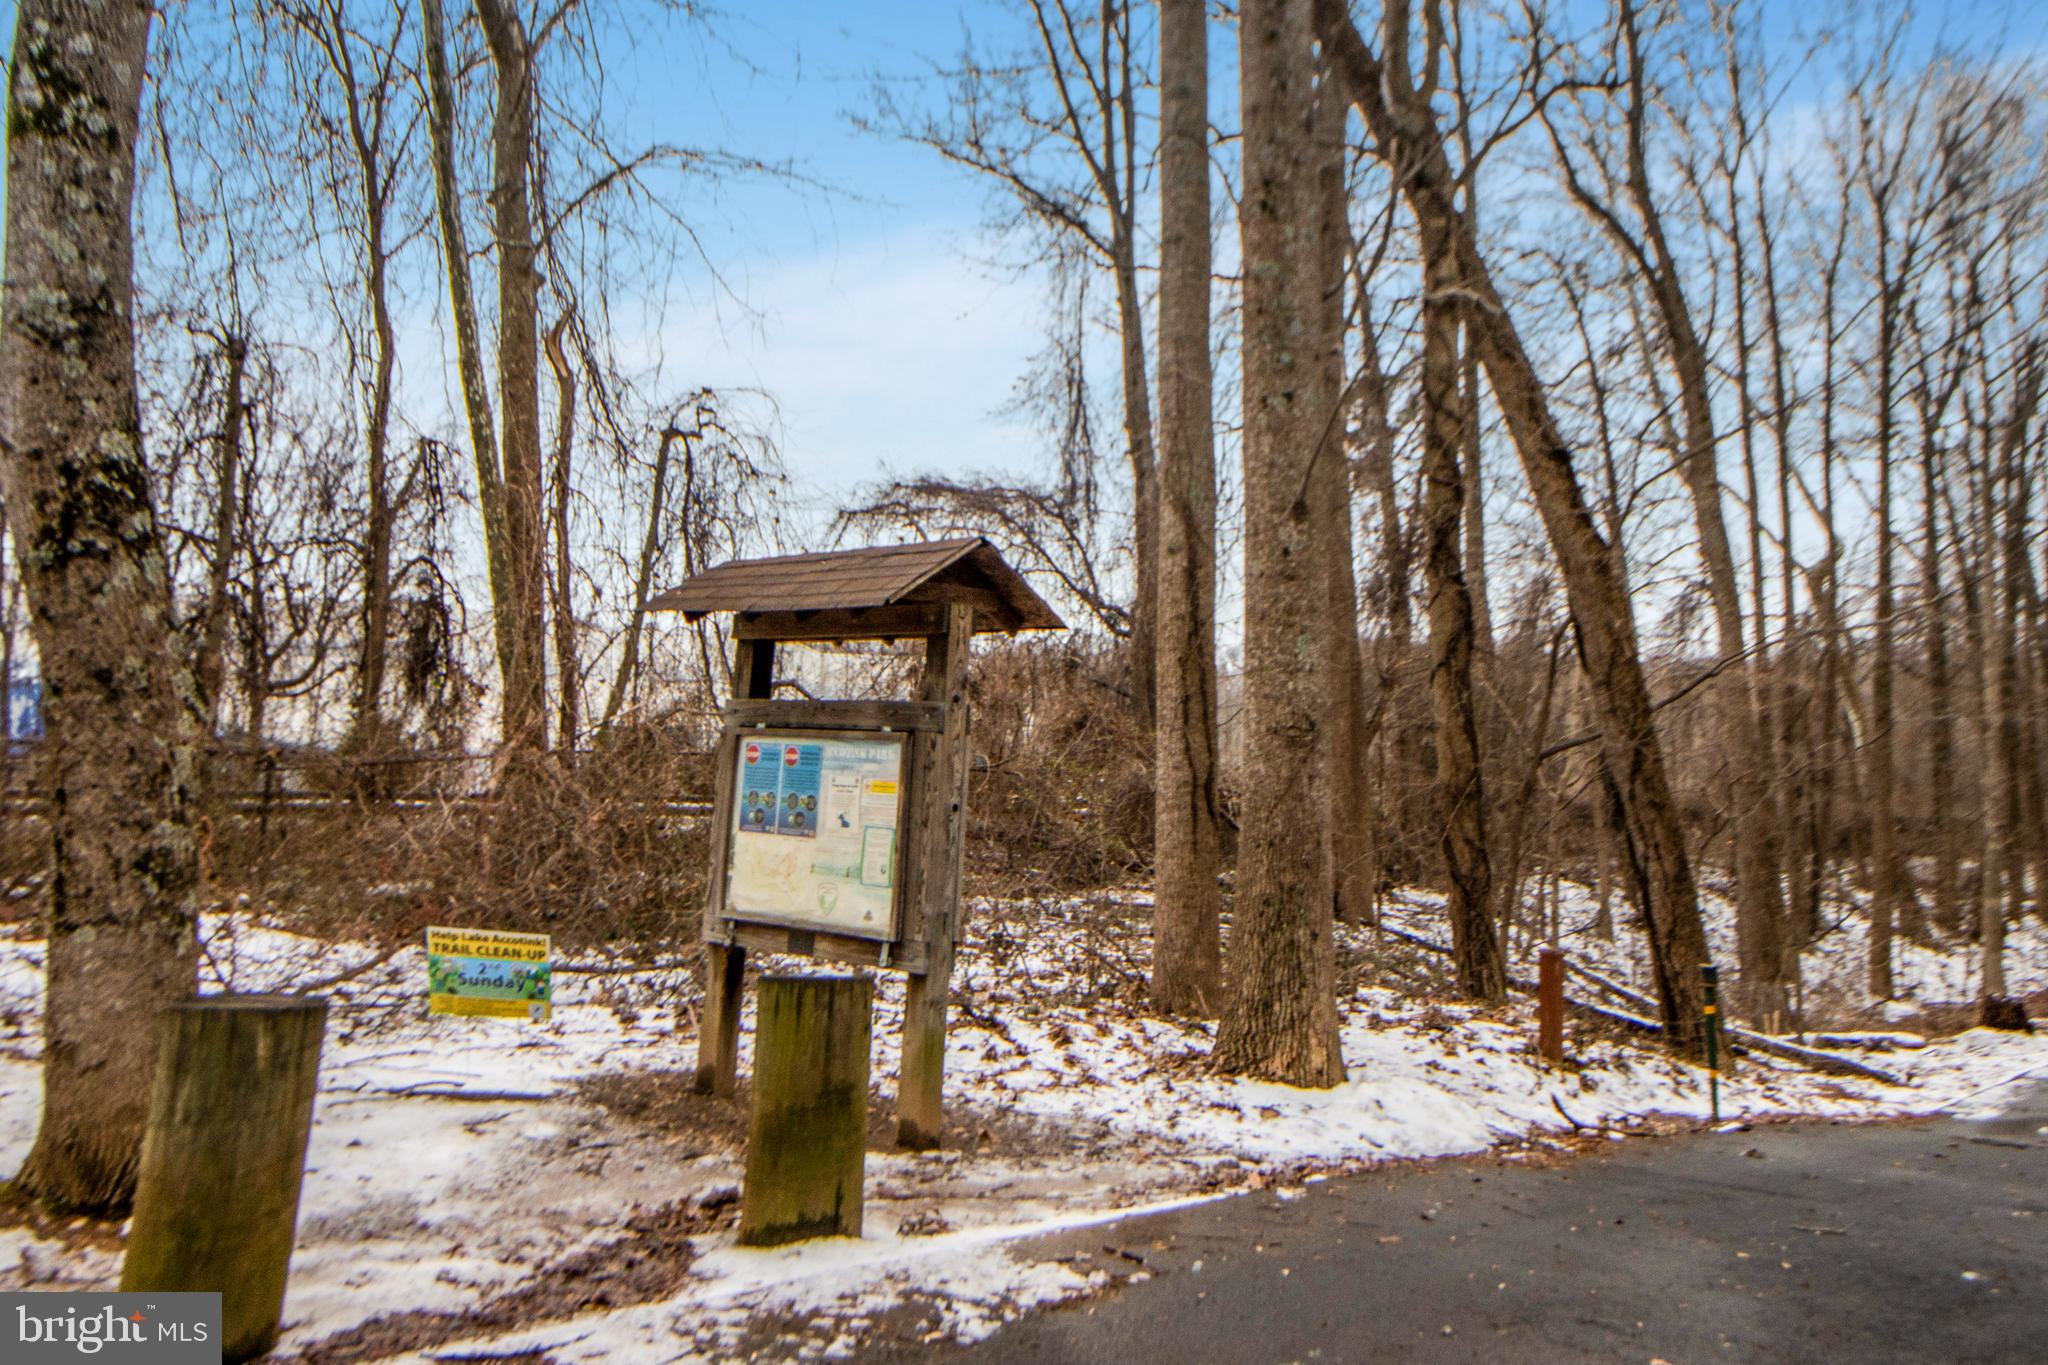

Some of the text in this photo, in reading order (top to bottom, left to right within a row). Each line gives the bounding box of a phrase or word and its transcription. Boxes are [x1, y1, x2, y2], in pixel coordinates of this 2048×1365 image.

[431, 930, 458, 941] Help
[462, 933, 488, 943] Lake
[433, 942, 546, 959] TRAIL CLEAN-UP
[457, 972, 526, 993] Sunday
